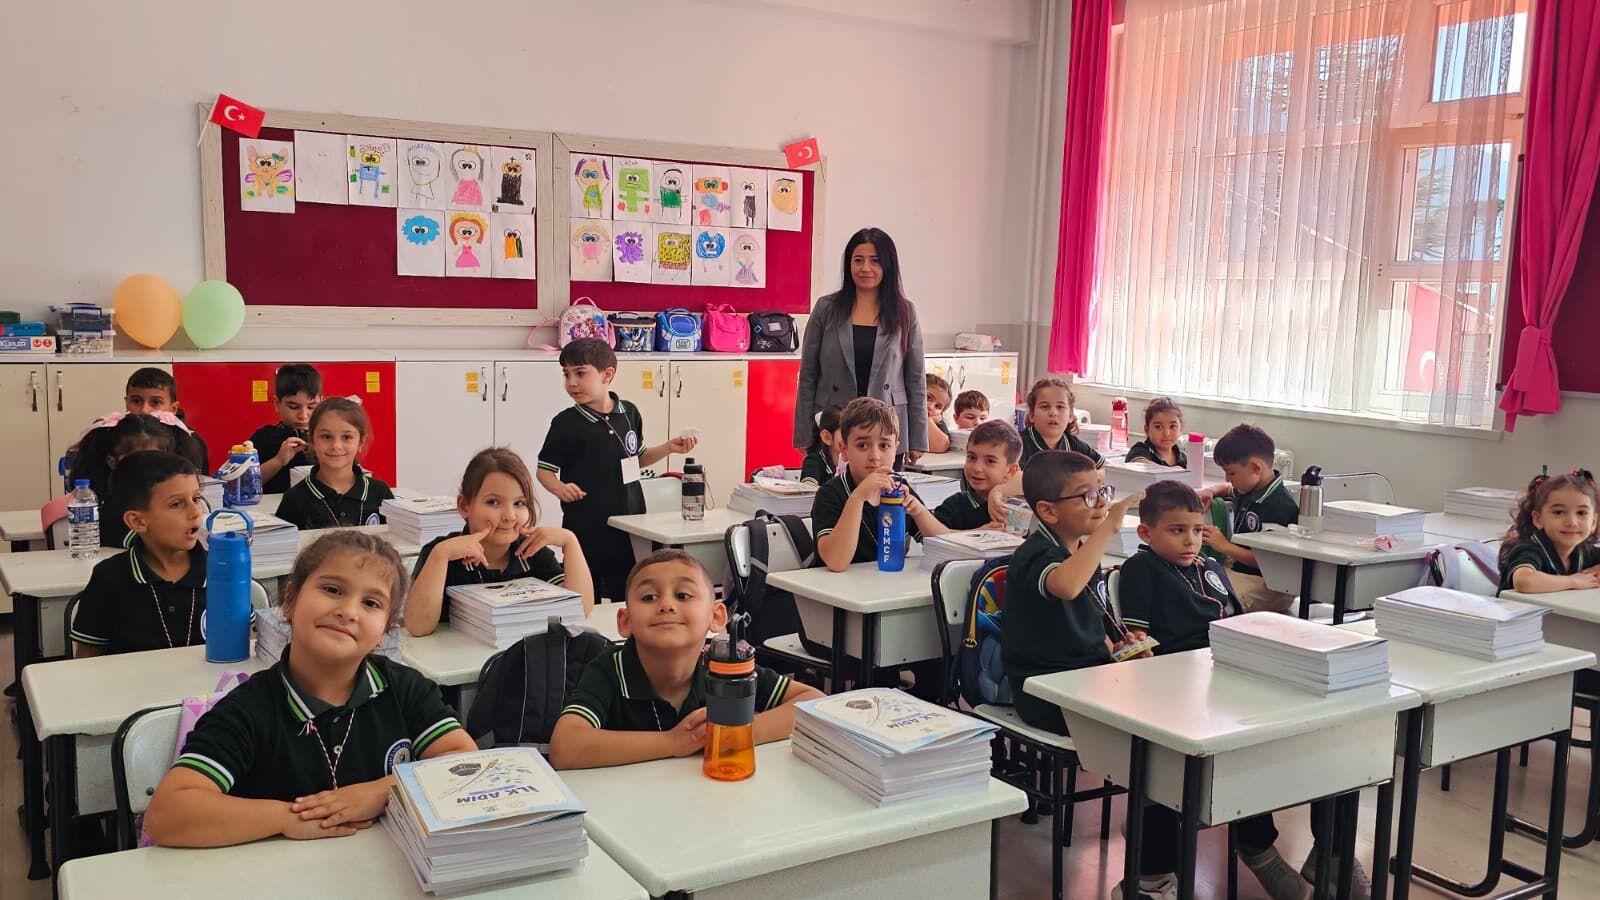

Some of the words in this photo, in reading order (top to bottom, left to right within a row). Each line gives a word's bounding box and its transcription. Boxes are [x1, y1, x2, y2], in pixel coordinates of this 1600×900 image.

[883, 527, 891, 563] RMCF
[505, 785, 540, 797] İLK
[456, 792, 500, 804] ADIM
